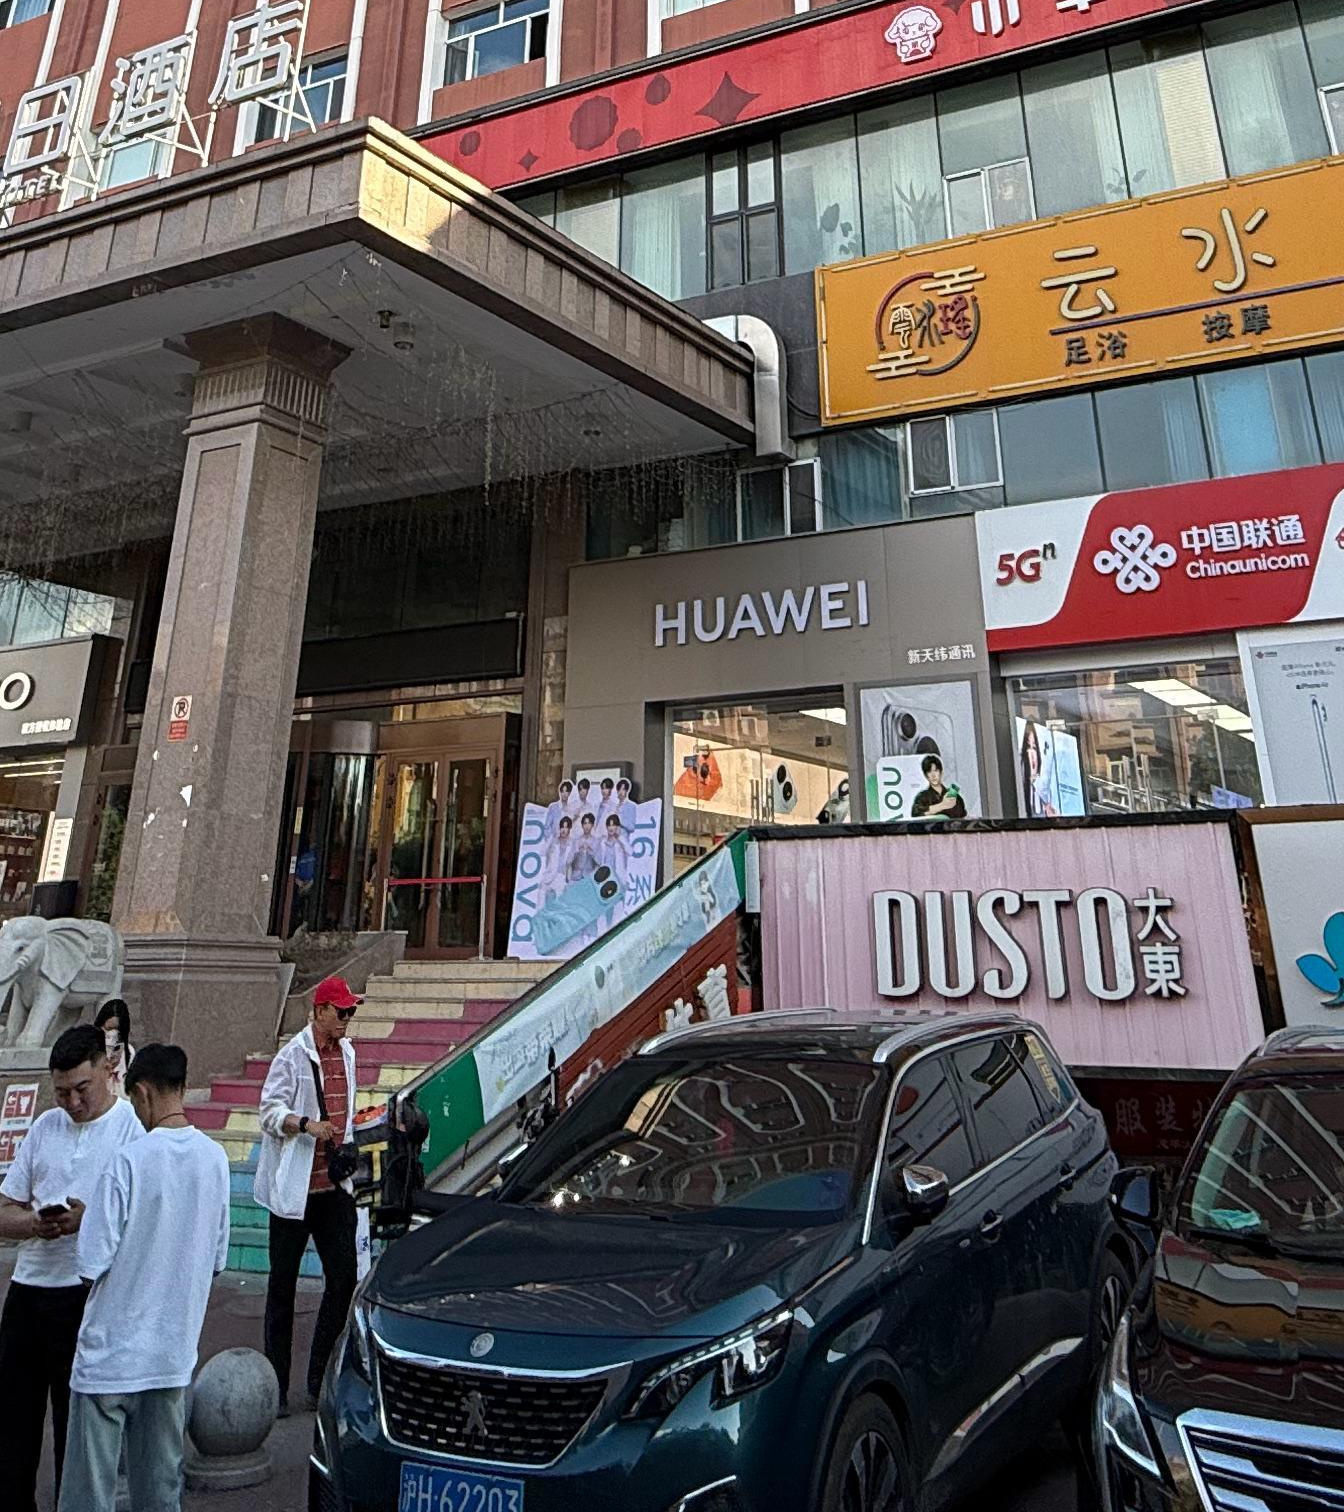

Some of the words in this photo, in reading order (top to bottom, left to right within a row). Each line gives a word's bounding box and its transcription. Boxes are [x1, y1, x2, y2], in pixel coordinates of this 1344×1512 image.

[1064, 330, 1128, 366] 足浴
[1203, 305, 1272, 345] 按摩
[1181, 515, 1305, 556] 中国联通
[655, 581, 868, 646] HUAWEI
[907, 644, 976, 664] 新天纬通讯
[512, 820, 545, 942] nova
[872, 888, 1137, 1002] DUSTO
[1134, 887, 1186, 999] 大東
